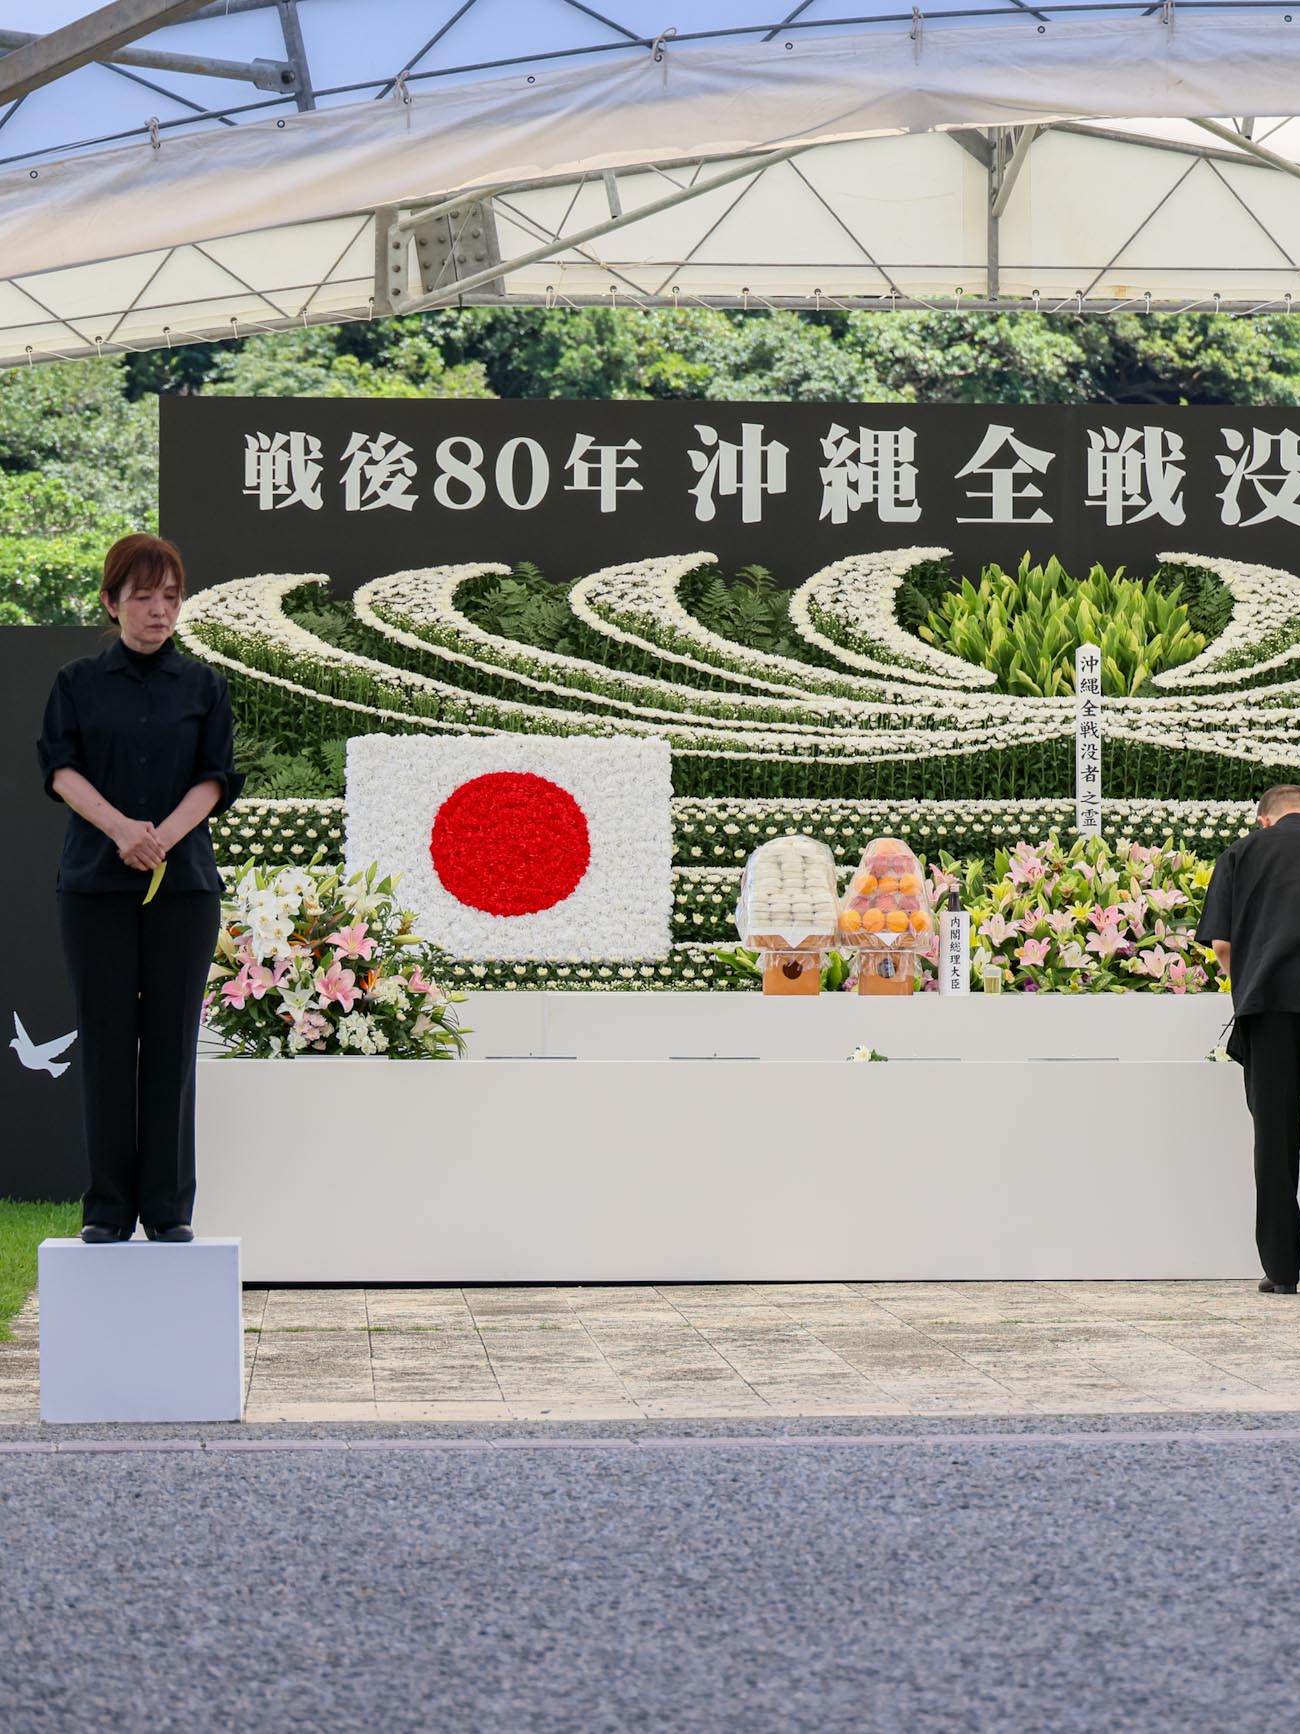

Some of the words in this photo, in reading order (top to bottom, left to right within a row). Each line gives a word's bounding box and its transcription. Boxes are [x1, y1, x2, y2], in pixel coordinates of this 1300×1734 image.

[243, 432, 643, 513] 戦後80年
[1080, 655, 1099, 827] 沖縄全戦没者之霊
[950, 916, 961, 990] 内閣総理大臣
